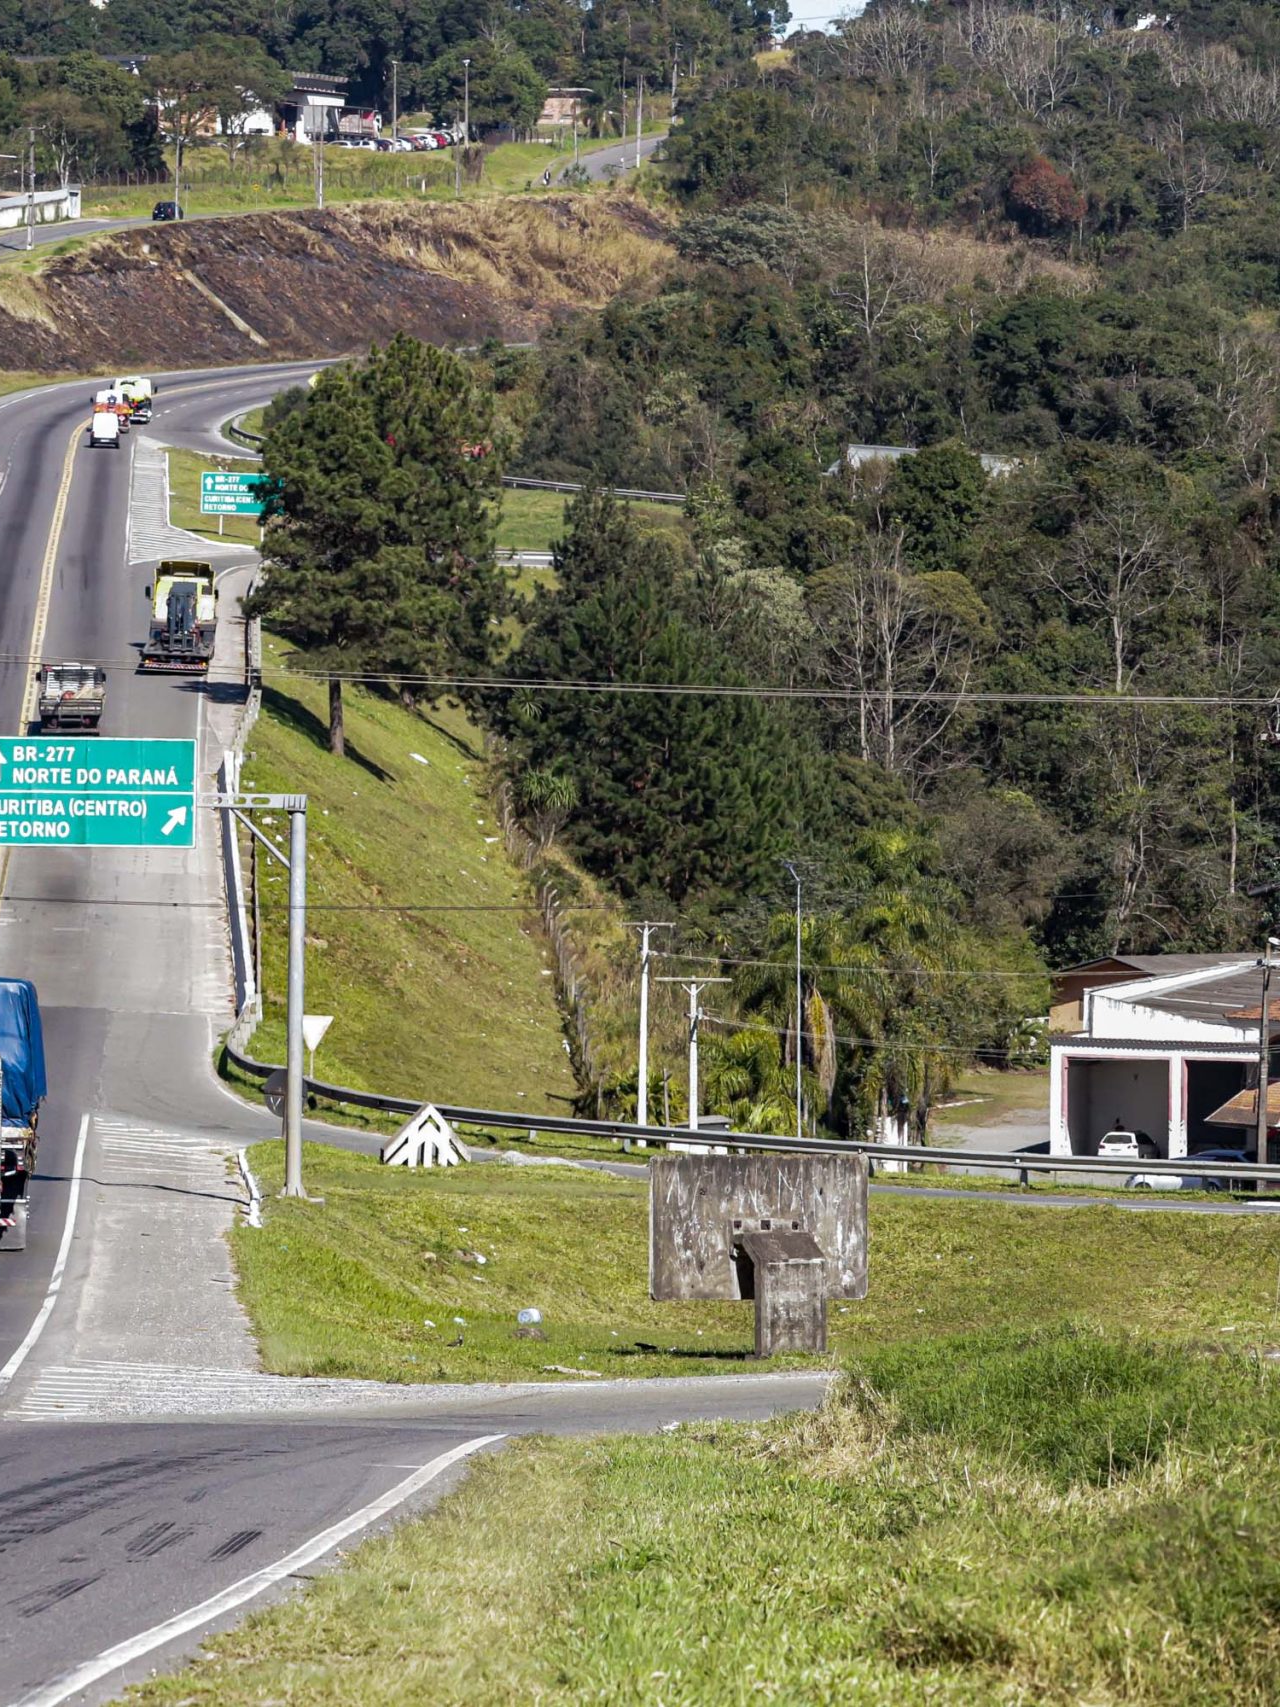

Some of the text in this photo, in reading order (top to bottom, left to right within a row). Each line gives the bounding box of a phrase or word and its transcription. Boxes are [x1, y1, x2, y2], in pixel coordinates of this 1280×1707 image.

[12, 745, 76, 762] BR-277
[12, 766, 179, 786] NORTE DO PARANÁ
[68, 797, 147, 819] (CENTRO)
